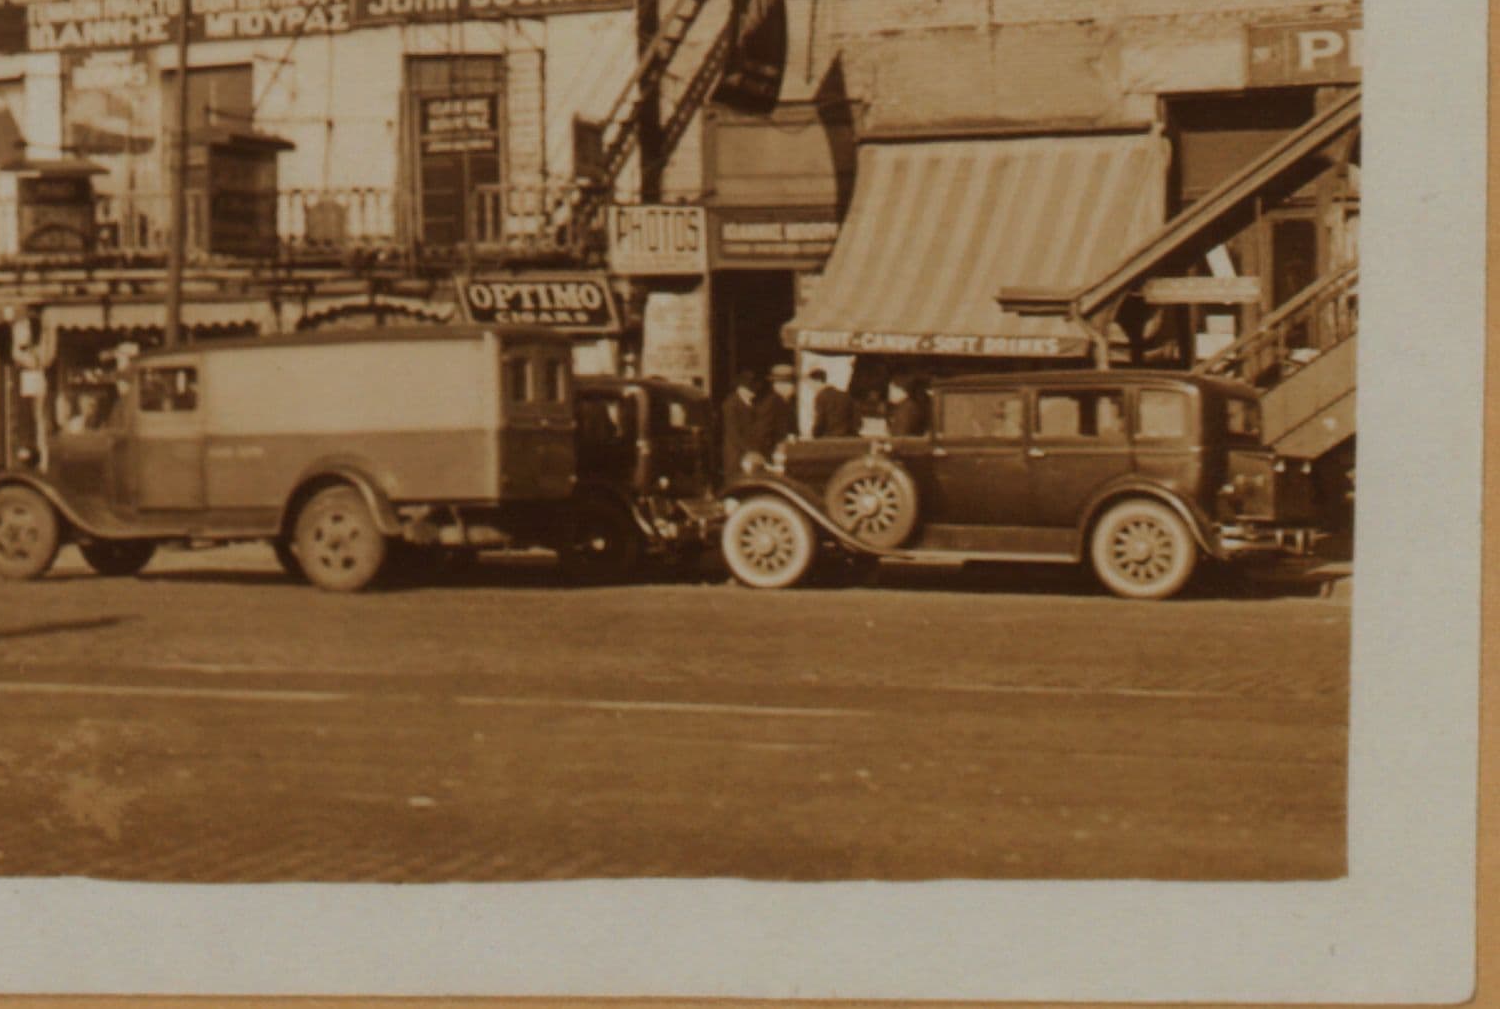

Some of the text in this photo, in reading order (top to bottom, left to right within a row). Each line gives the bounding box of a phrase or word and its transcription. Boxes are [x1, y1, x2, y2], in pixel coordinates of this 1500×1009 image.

[616, 209, 699, 252] PHOTOS
[468, 281, 602, 311] OPTIMO
[496, 310, 590, 324] CIGARS
